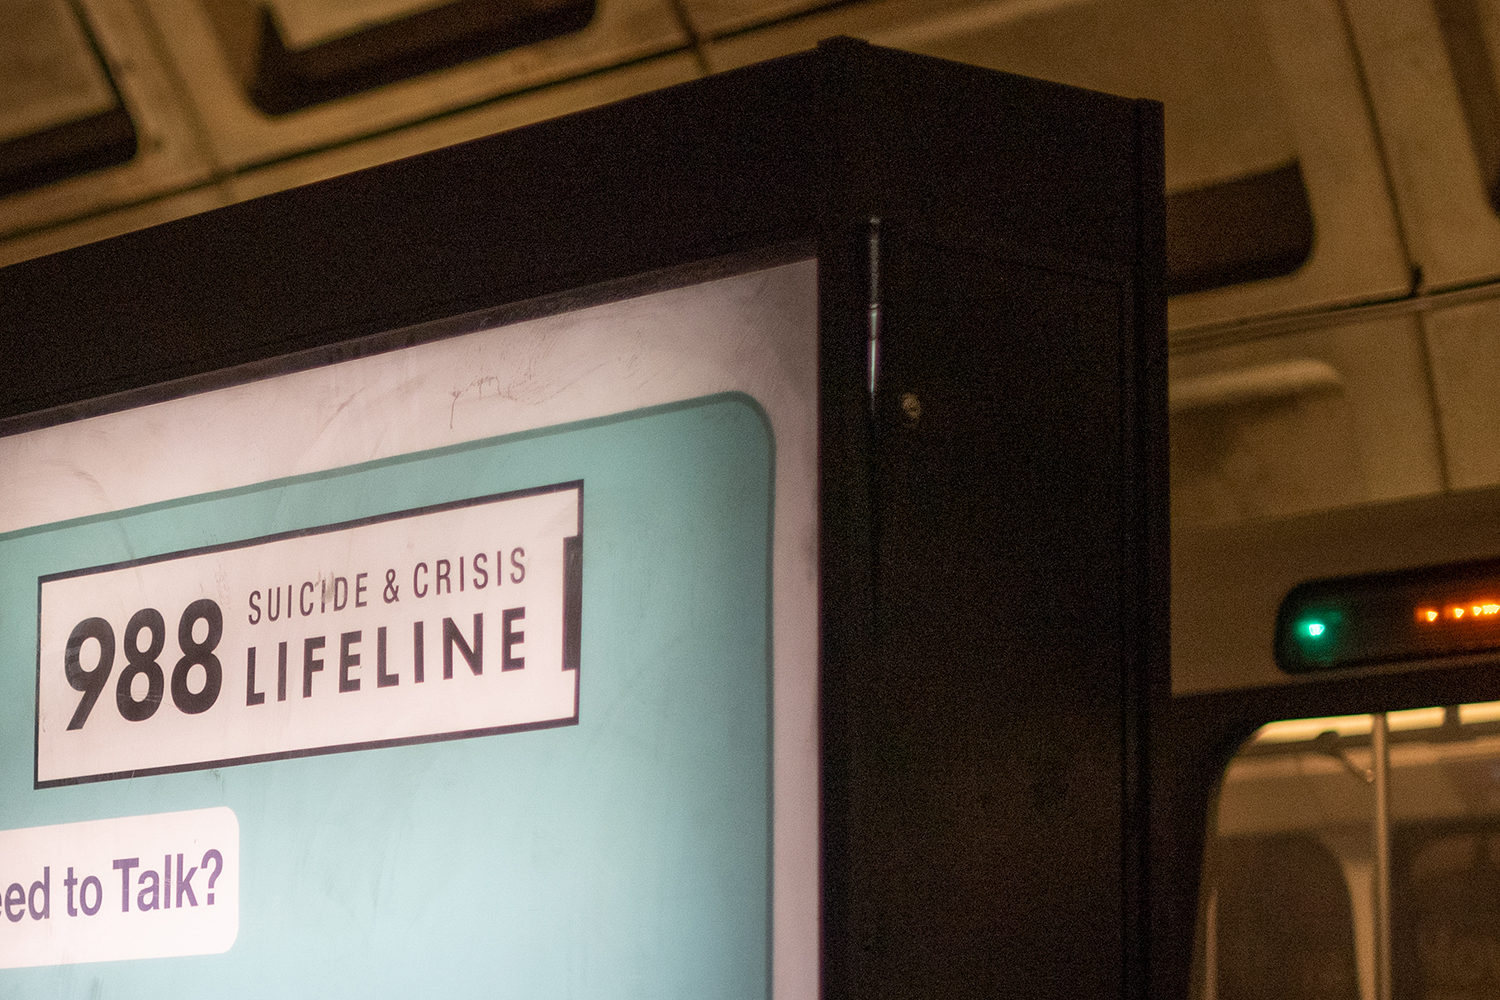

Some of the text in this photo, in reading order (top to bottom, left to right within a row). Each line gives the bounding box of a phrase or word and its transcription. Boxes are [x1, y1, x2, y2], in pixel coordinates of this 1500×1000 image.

[248, 546, 527, 626] SUICIDE & CRISIS
[64, 598, 225, 731] 988
[245, 606, 526, 707] LIFELINE
[63, 866, 103, 917] to
[112, 848, 223, 914] Talk?
